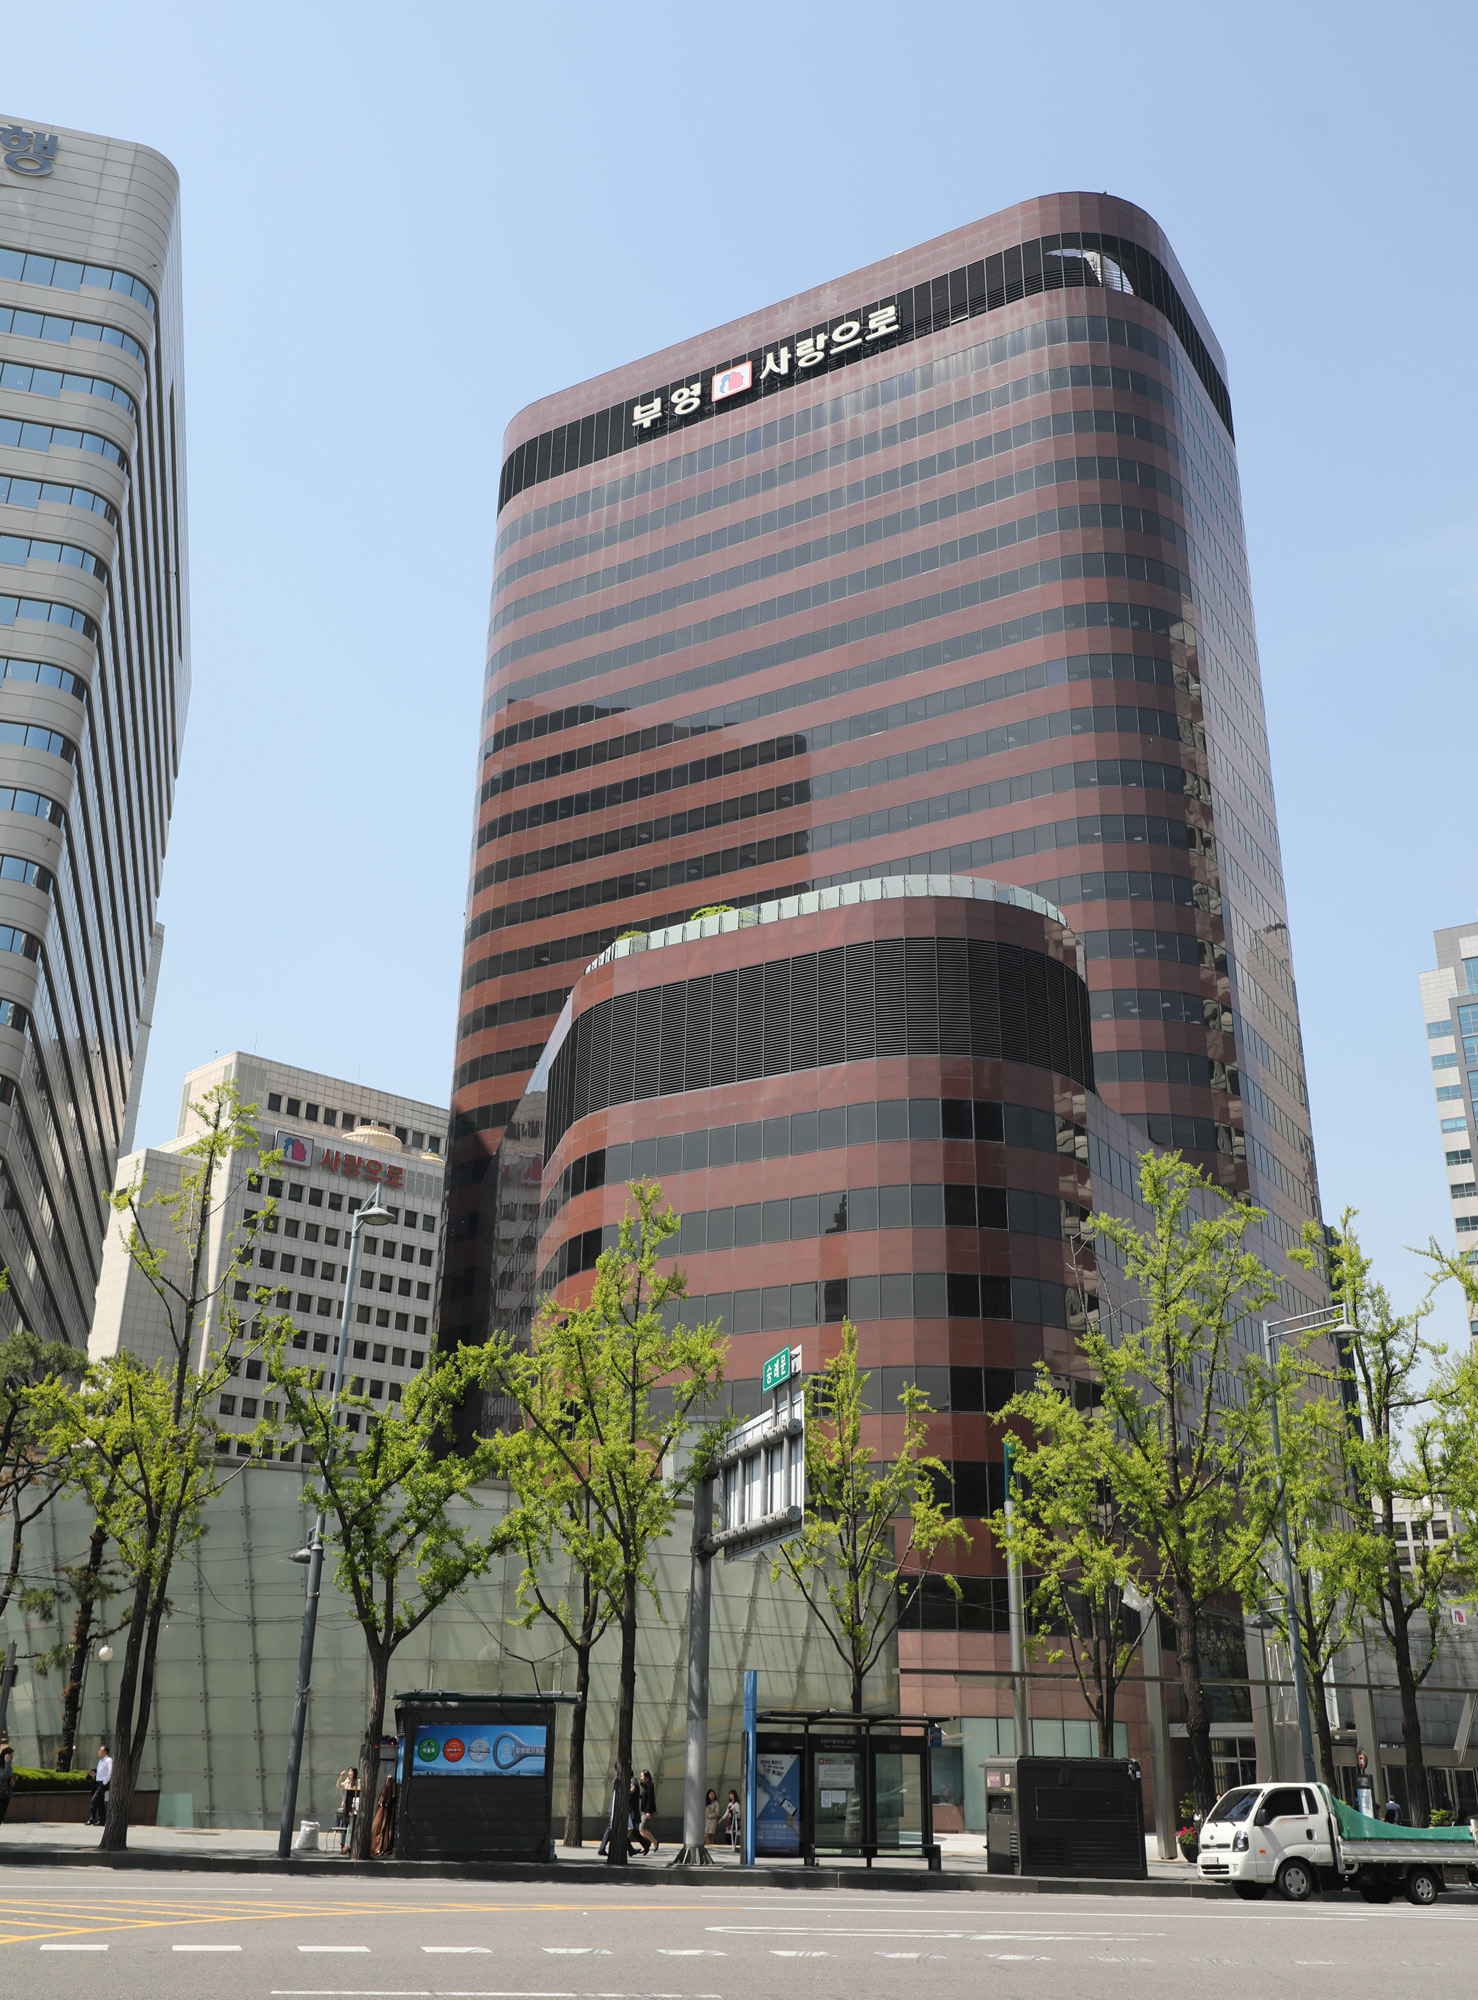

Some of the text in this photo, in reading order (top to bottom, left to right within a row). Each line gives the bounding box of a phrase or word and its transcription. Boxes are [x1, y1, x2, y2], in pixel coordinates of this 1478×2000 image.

[0, 124, 58, 176] 행
[632, 304, 900, 428] 부영 사랑으로
[320, 1148, 404, 1187] 사랑으로
[766, 1354, 786, 1384] 숭례문
